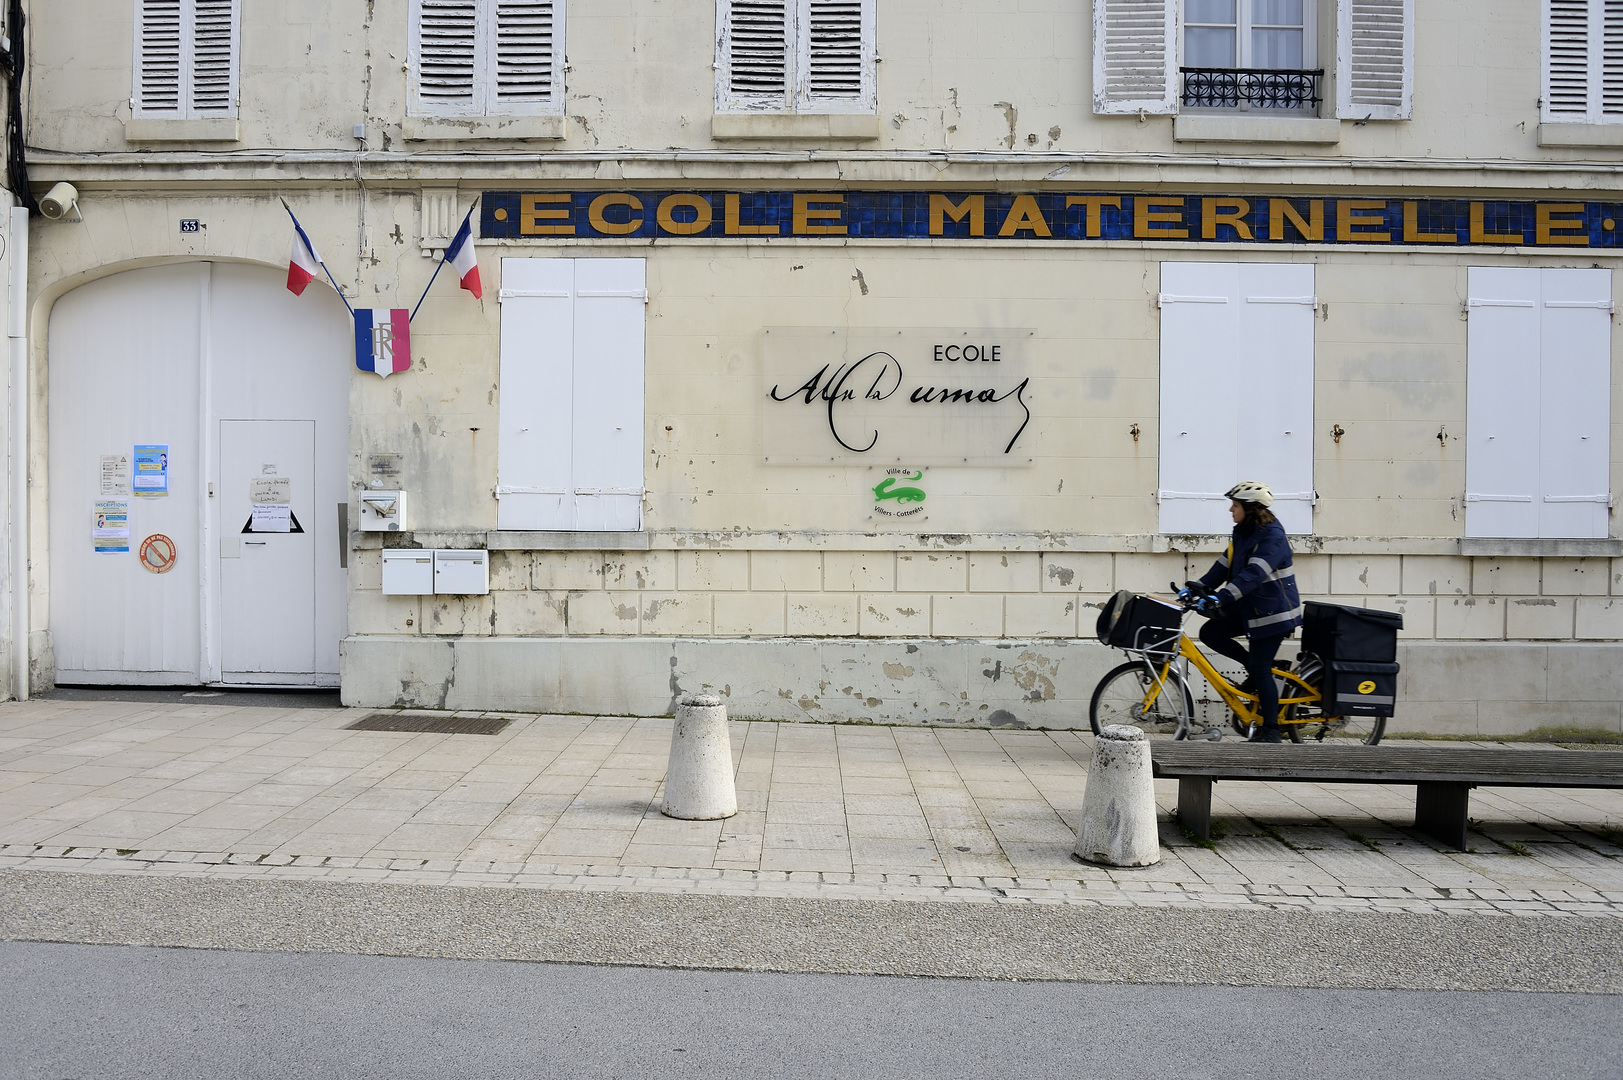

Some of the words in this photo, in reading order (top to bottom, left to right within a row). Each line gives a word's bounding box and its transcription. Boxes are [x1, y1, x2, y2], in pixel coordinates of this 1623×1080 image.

[520, 192, 848, 235] ECOLE
[929, 194, 1589, 245] MATERNELLE
[183, 221, 196, 231] 33
[934, 345, 1001, 362] ECOLE
[874, 505, 892, 516] Villers
